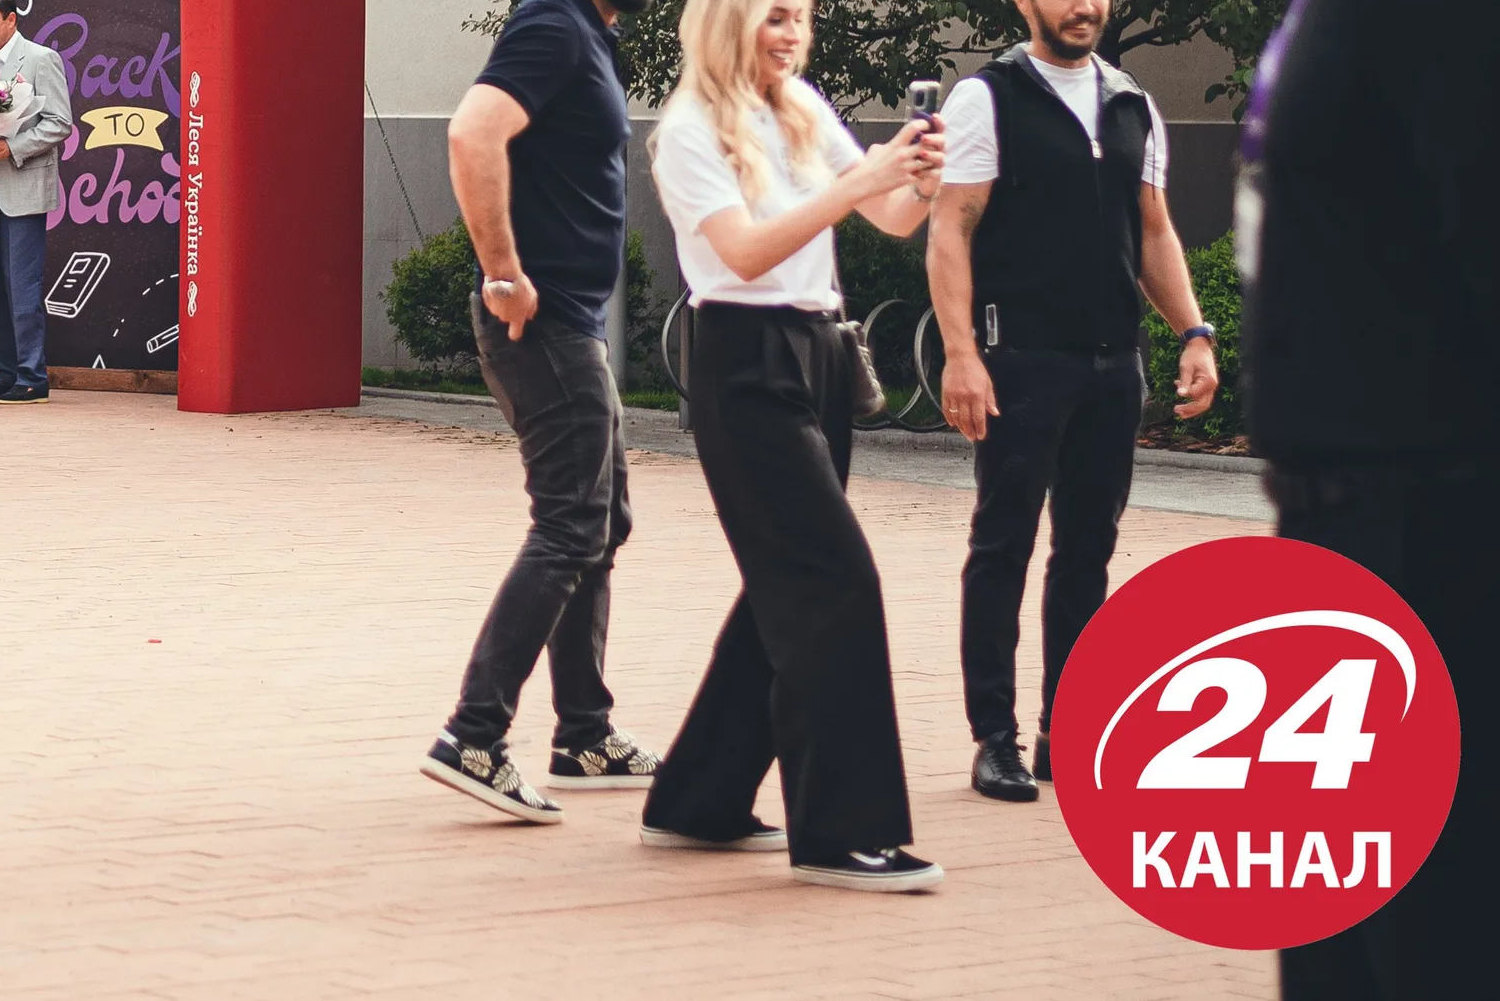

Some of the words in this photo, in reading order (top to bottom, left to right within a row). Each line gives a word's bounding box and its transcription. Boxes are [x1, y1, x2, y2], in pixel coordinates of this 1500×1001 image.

[104, 113, 145, 137] TO
[188, 111, 204, 166] Леся
[45, 124, 181, 231] choo
[185, 172, 203, 276] Українка
